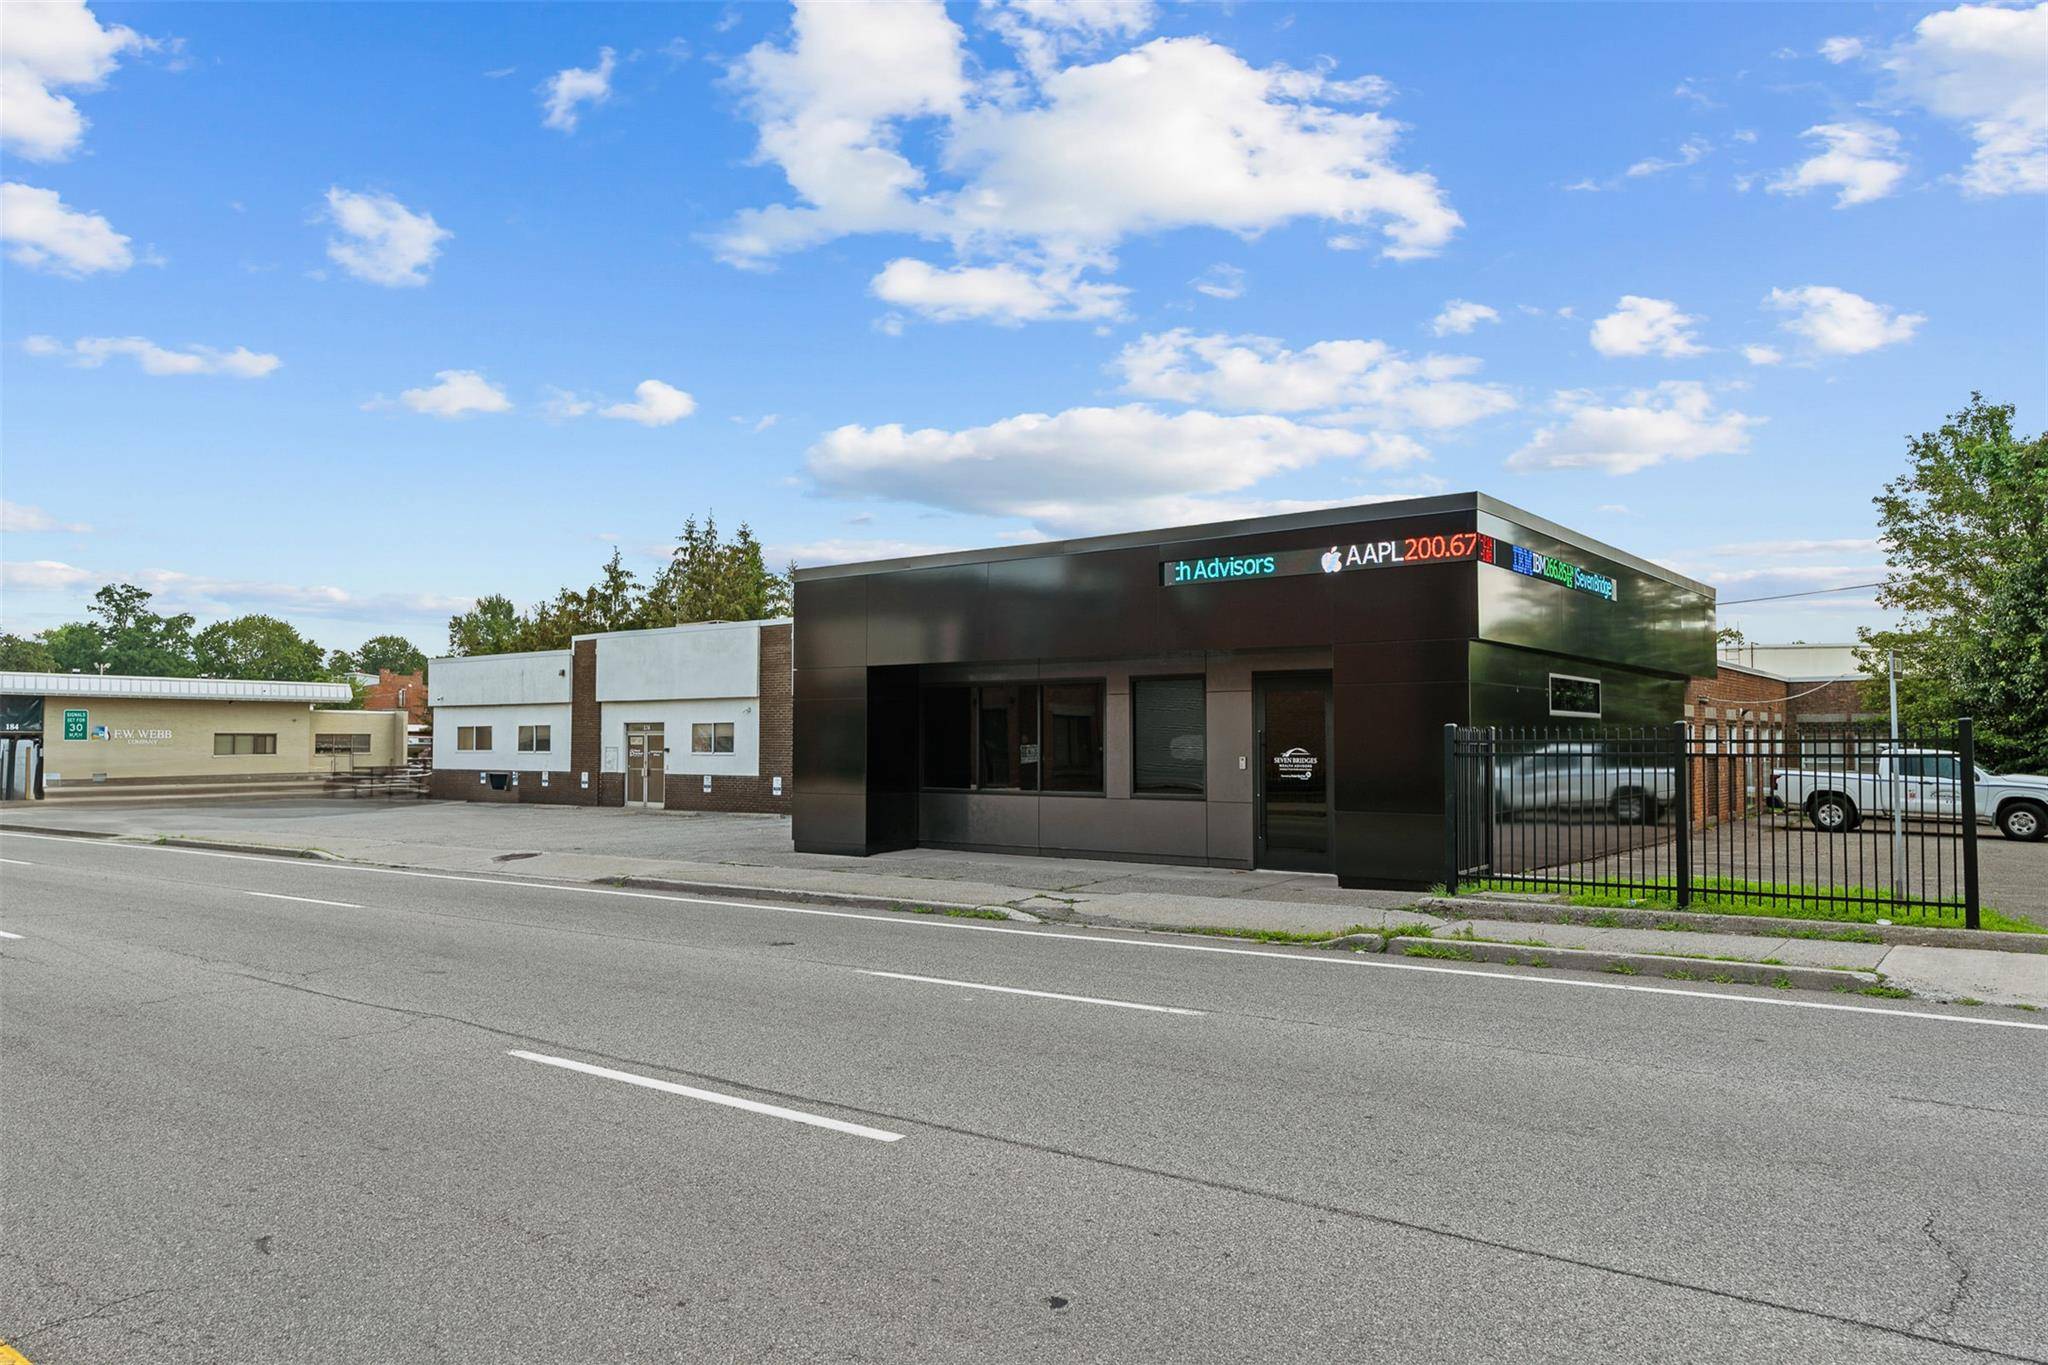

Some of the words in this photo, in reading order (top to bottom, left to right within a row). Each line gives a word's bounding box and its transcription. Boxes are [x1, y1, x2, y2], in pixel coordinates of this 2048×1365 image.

[1346, 541, 1404, 566] AAPL
[1404, 533, 1476, 561] 200.67
[1193, 557, 1275, 579] Advisors
[69, 723, 83, 732] 30
[138, 729, 173, 739] WEBB
